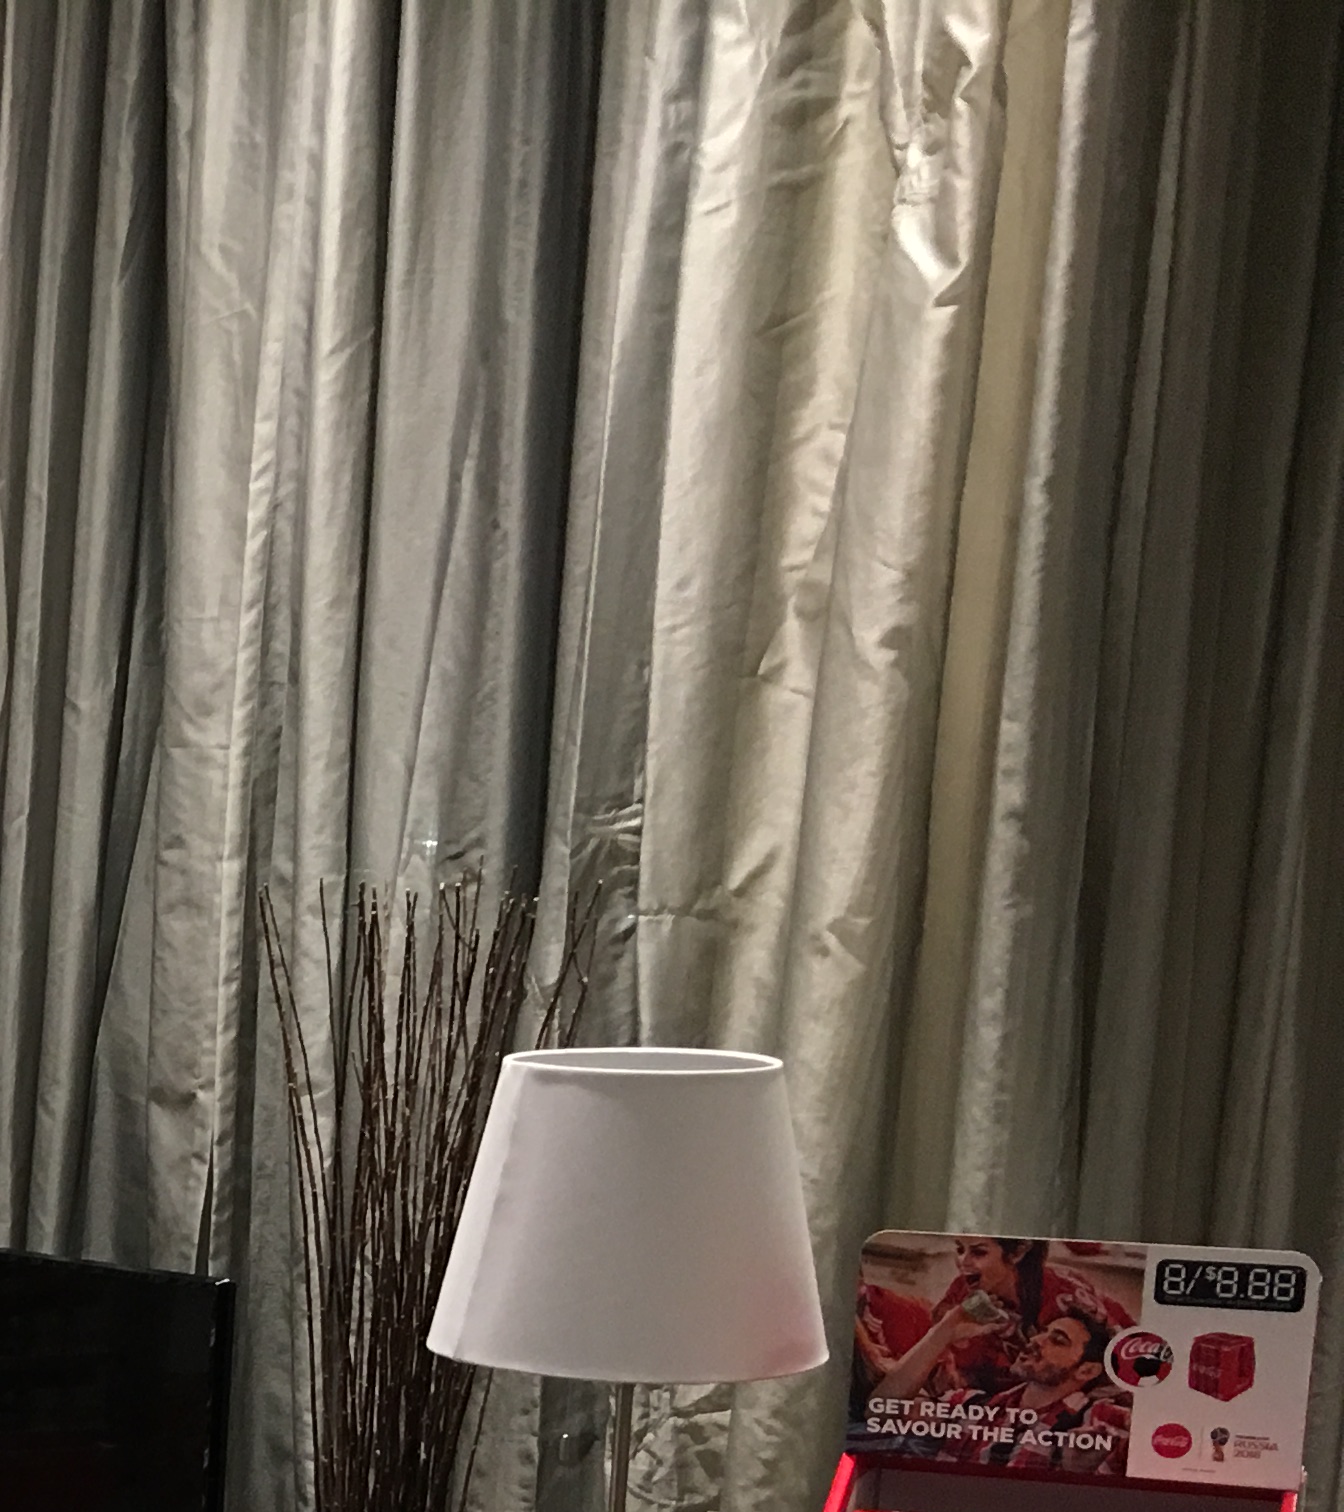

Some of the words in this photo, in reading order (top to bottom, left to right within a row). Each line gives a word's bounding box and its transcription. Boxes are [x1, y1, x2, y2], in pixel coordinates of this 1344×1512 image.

[868, 1397, 914, 1415] GET
[920, 1400, 1000, 1422] READY
[1006, 1406, 1038, 1425] TO
[867, 1417, 962, 1440] SAVOUR
[968, 1424, 1015, 1444] THE
[1019, 1429, 1113, 1452] ACTION
